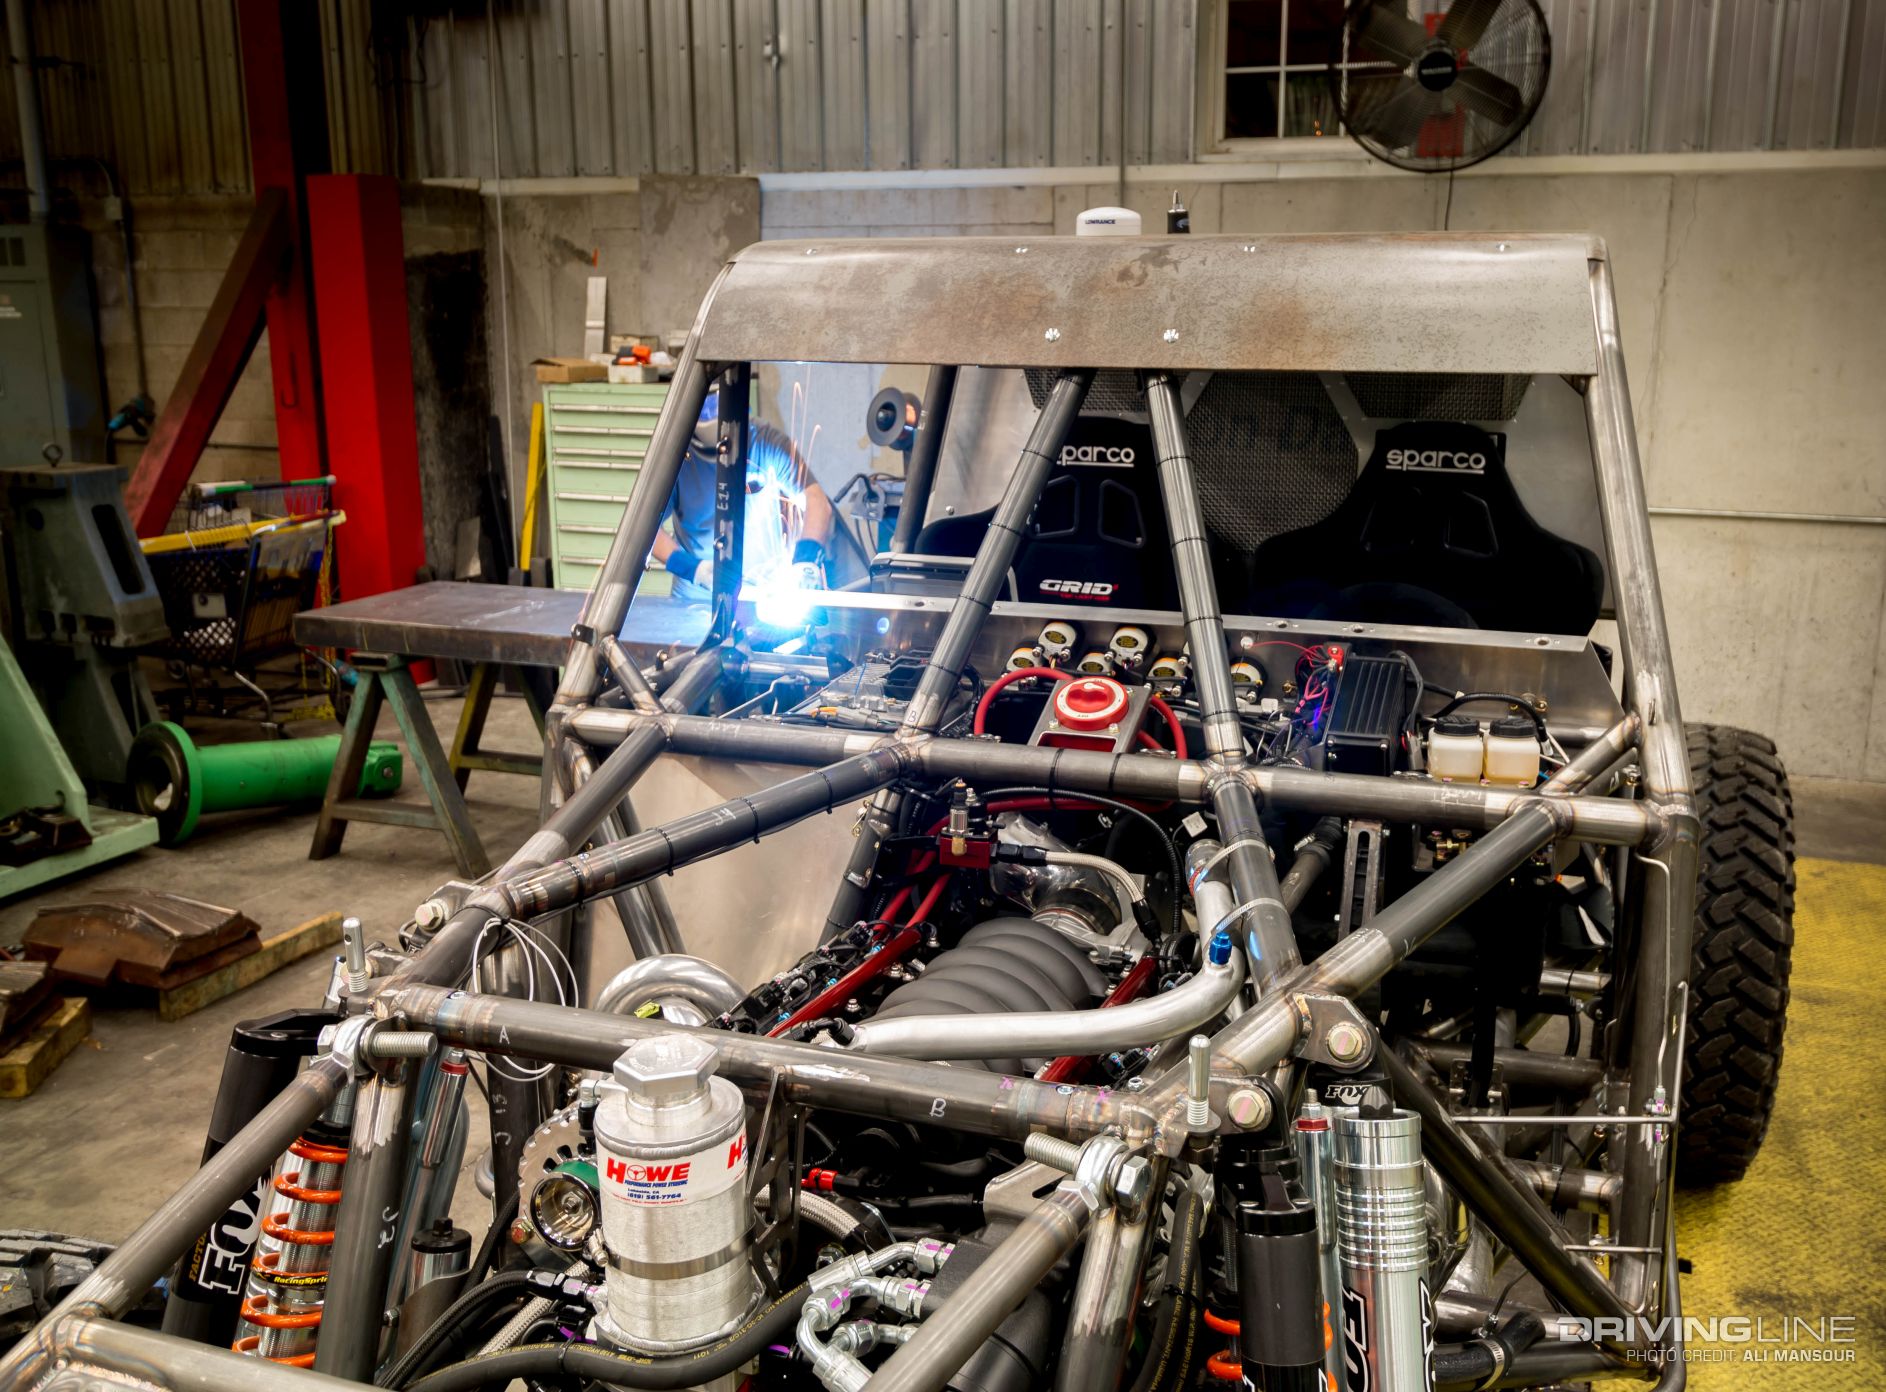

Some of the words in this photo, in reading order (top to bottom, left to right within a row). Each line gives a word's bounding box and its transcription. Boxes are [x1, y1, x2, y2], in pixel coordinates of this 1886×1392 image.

[1057, 445, 1135, 467] parco
[1386, 448, 1486, 473] sparco
[1039, 579, 1113, 596] GRID
[499, 1025, 510, 1045] A
[929, 1097, 947, 1118] B
[606, 1157, 691, 1184] HOWE
